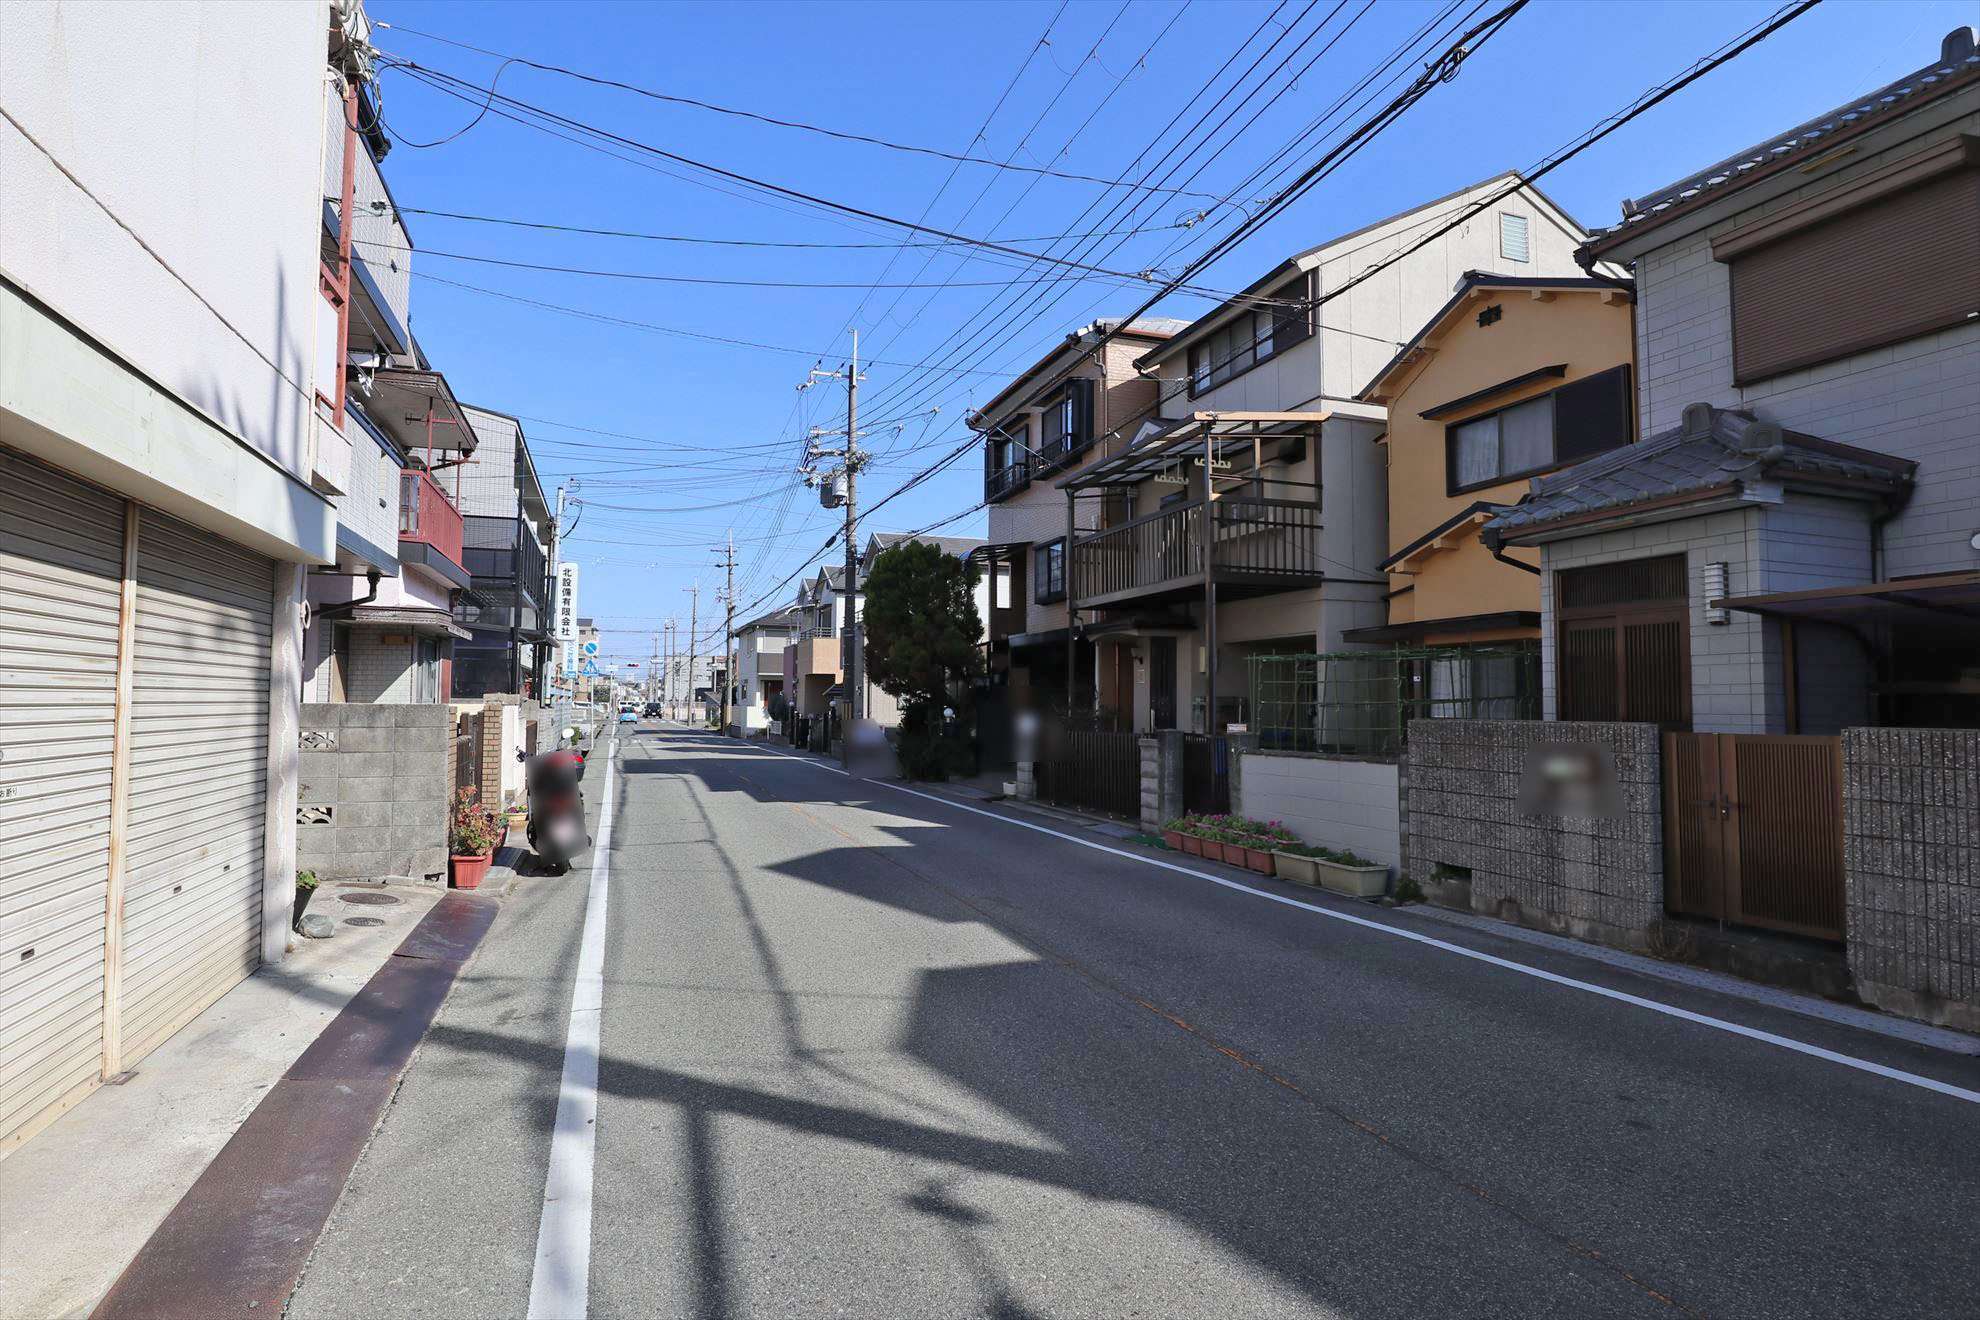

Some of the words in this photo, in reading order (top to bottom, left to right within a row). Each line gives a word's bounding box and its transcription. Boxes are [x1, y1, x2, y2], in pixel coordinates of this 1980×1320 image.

[561, 568, 572, 636] 北設備有限会社
